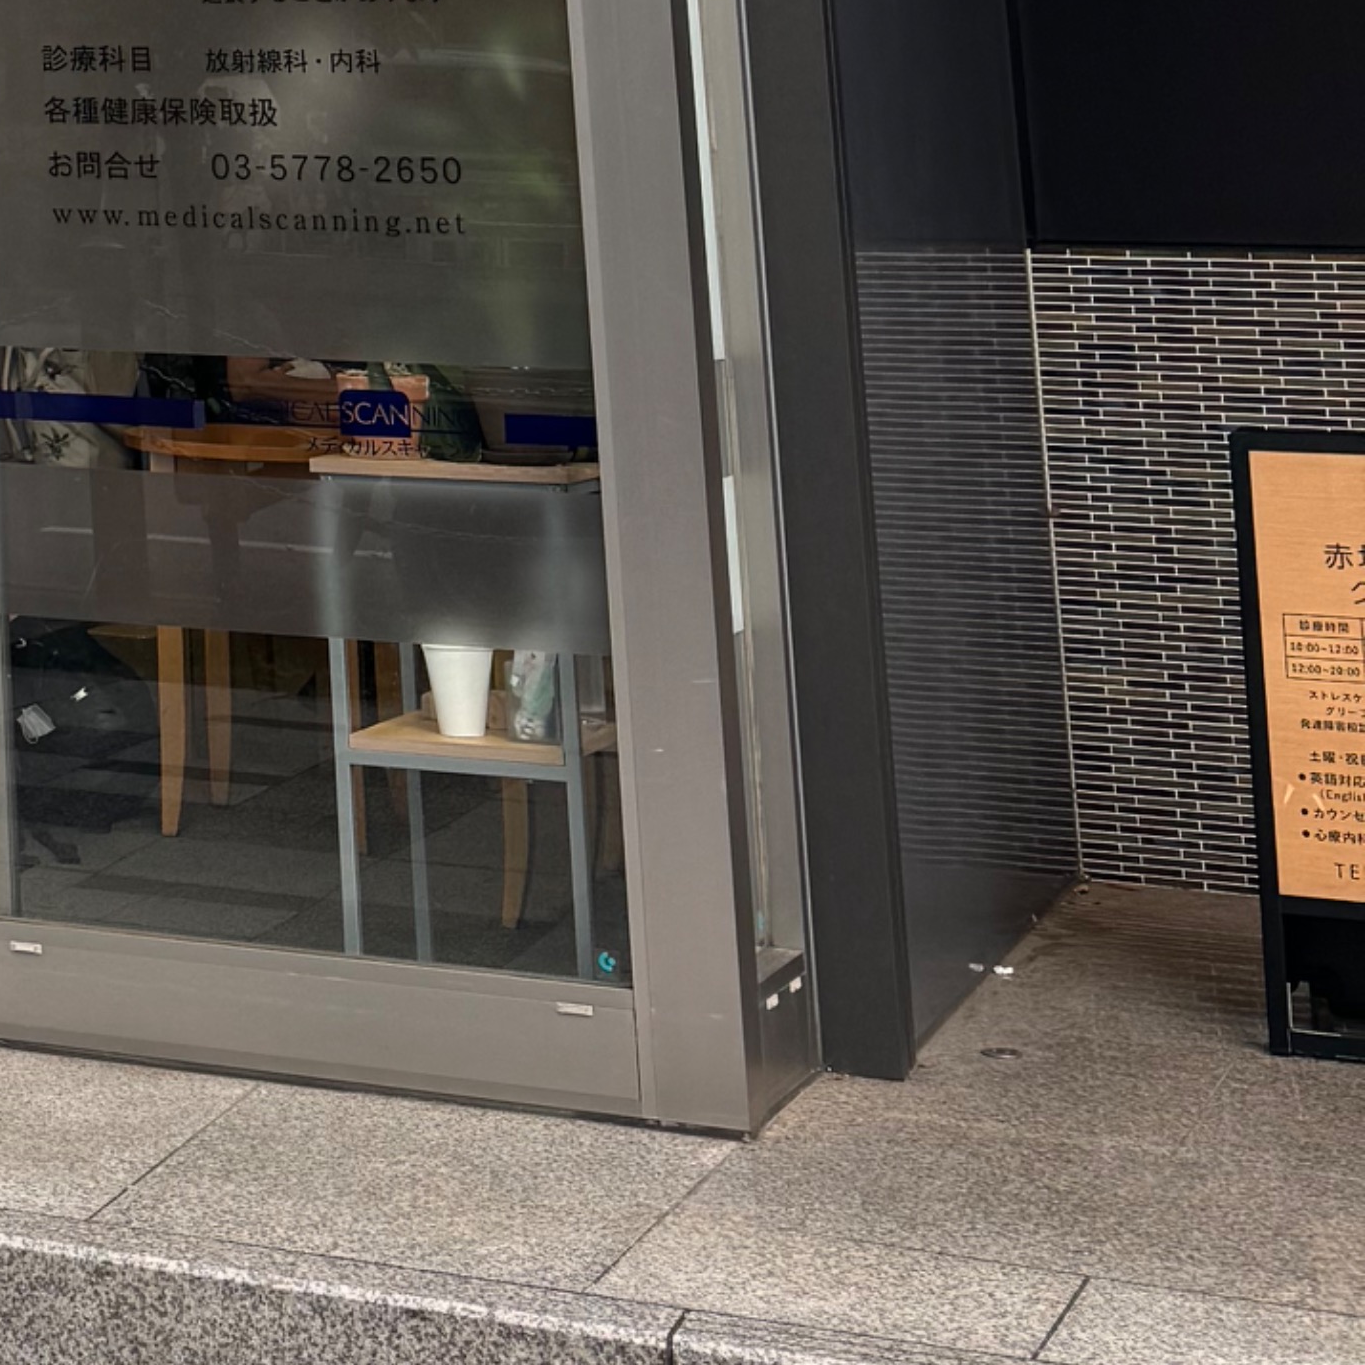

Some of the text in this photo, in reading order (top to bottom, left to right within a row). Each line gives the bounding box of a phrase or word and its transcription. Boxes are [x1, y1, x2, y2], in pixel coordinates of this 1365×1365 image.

[41, 44, 152, 72] 診療科目
[44, 97, 278, 127] 各種健康保険取扱
[48, 151, 462, 185] お問合せ 03-5778-2650
[52, 204, 466, 238] www.medicalscanning.net
[1324, 542, 1365, 570] 赤
